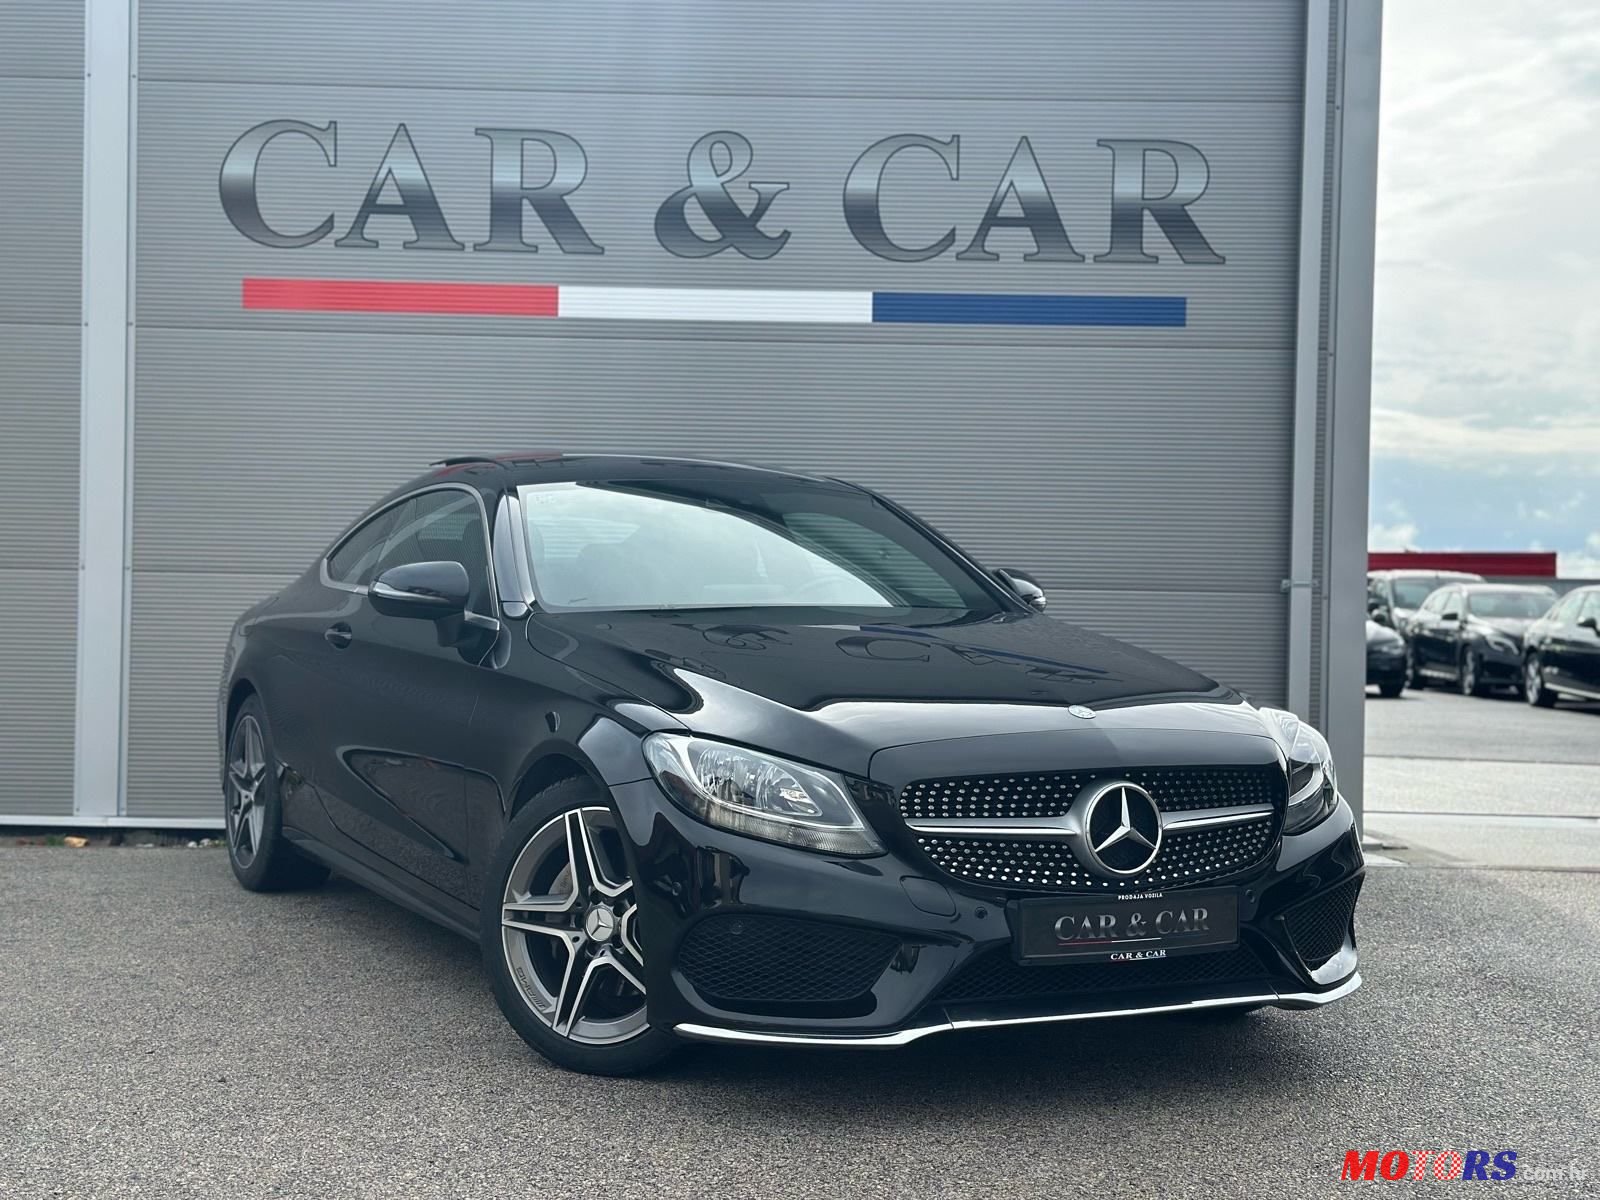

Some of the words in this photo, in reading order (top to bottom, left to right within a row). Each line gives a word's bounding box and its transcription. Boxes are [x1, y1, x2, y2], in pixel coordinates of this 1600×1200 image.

[218, 118, 606, 256] CAR
[653, 130, 793, 261] &
[842, 132, 1226, 265] CAR
[1117, 893, 1144, 901] PRODAJA
[1054, 914, 1119, 941] CAR
[1125, 912, 1148, 937] &
[1155, 907, 1210, 935] CAR
[1110, 952, 1133, 960] CAR
[1145, 949, 1167, 958] CAR
